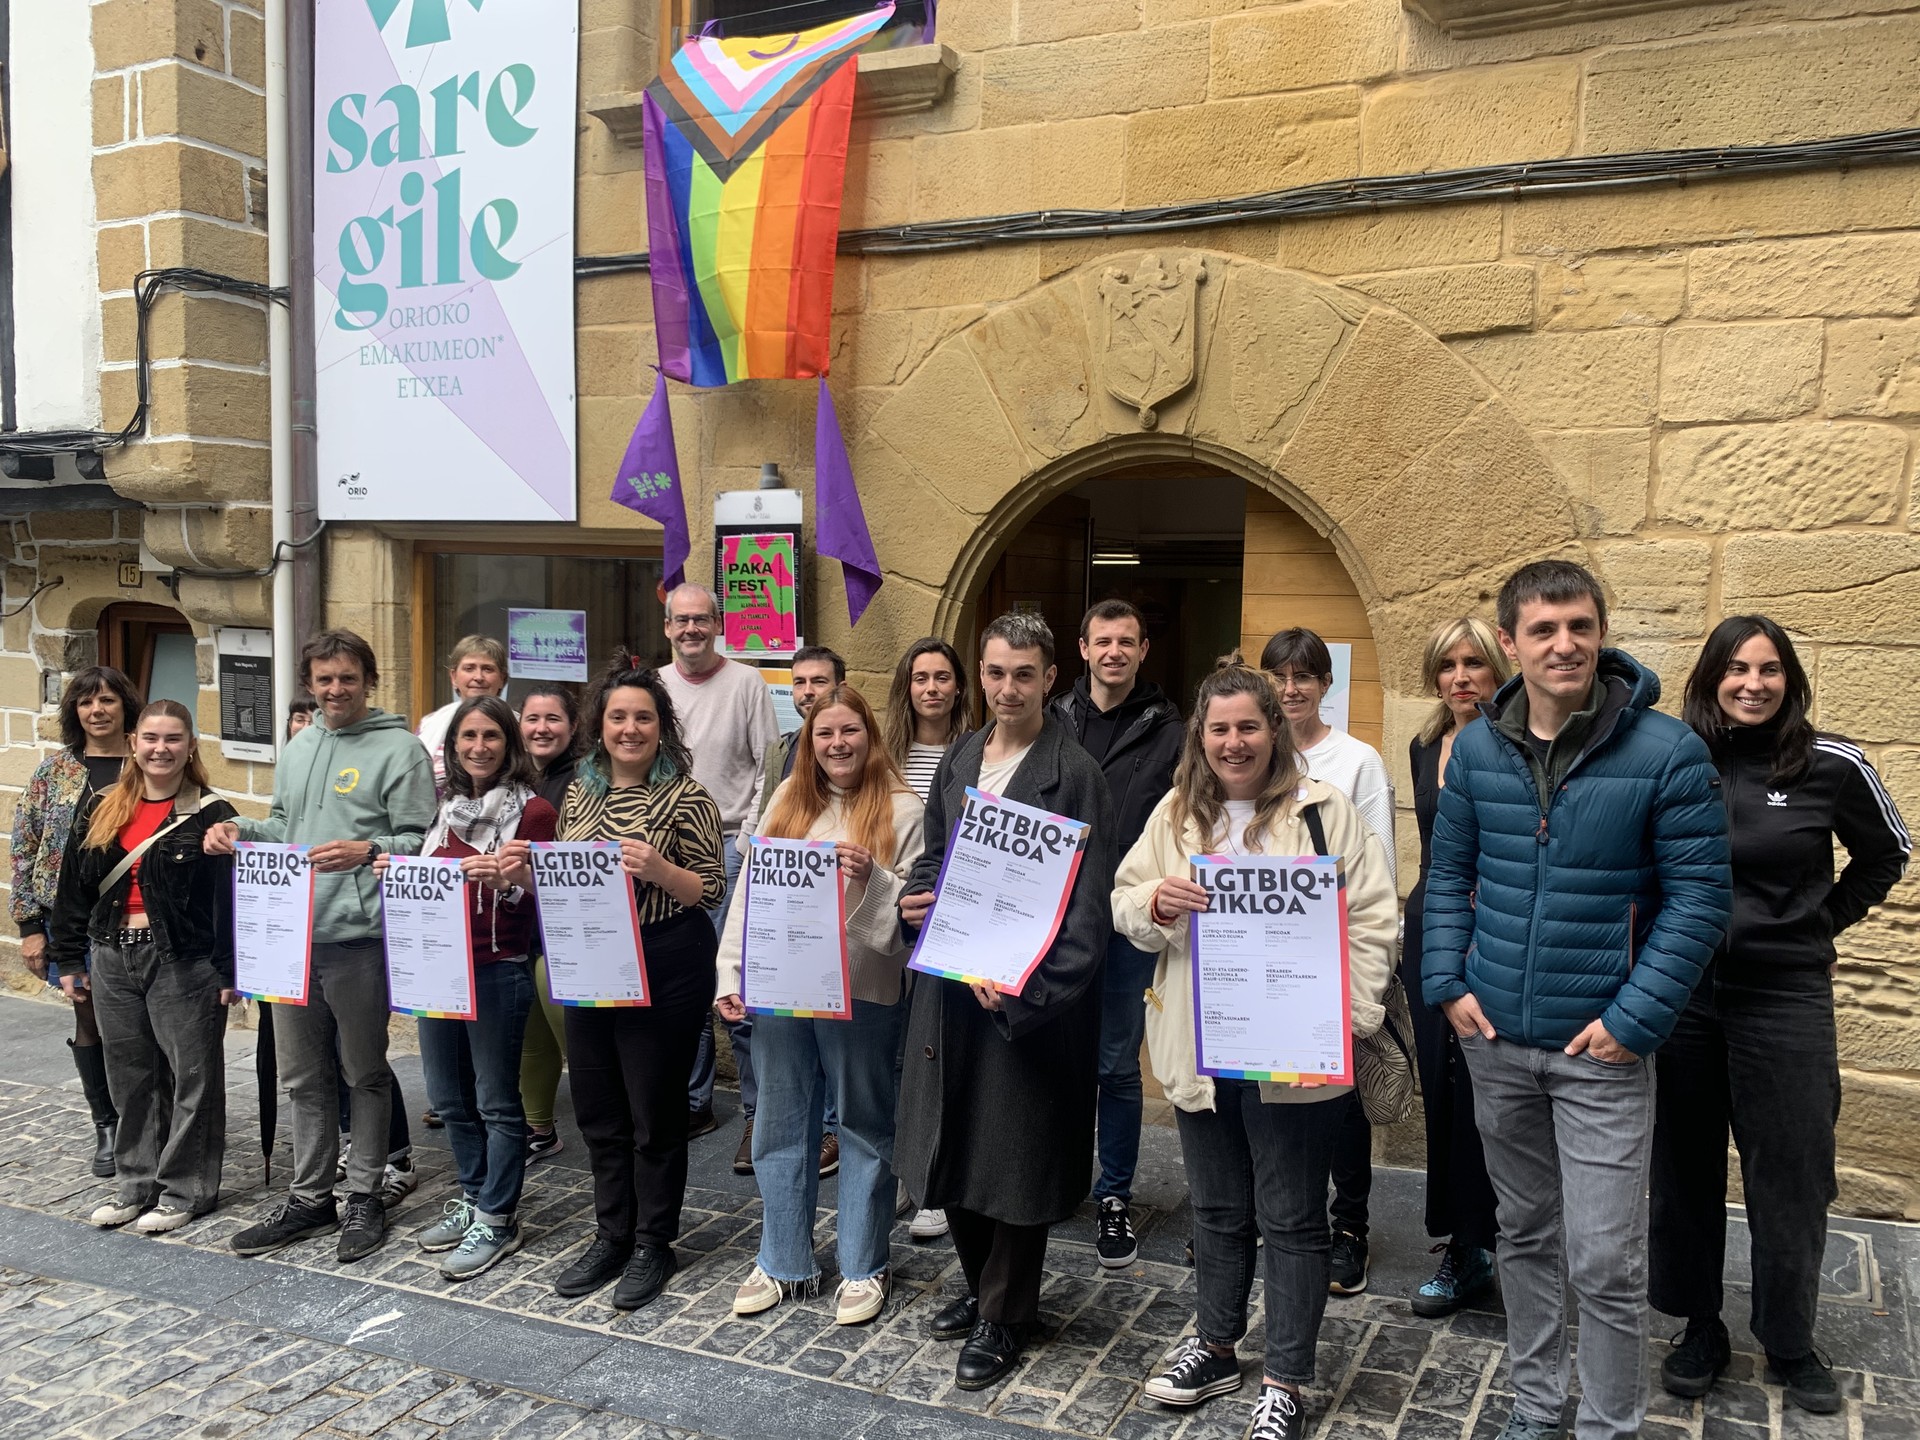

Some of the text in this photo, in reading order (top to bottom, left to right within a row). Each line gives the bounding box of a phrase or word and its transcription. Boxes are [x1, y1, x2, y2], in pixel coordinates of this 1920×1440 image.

[326, 63, 540, 174] sare
[335, 167, 523, 331] gile
[390, 302, 470, 329] ORIOKO
[397, 376, 463, 398] ETXEA
[348, 487, 368, 496] ORIO
[125, 566, 136, 582] 15
[728, 562, 772, 574] PAKA
[729, 580, 766, 592] FEST
[536, 645, 585, 656] TOPAKETA
[964, 800, 1076, 856] LGTBIQ+
[960, 821, 1044, 864] ZIKLOA
[238, 850, 309, 876] LGTBIQ+
[534, 851, 620, 875] LGTBIQ+
[752, 847, 835, 877] LGTBIQ+
[238, 868, 292, 886] ZIKLOA
[385, 865, 462, 891] LGTBIQ+
[537, 871, 605, 887] ZIKLOA
[751, 868, 814, 888] ZIKLOA
[1200, 868, 1334, 900] LGTBIQ+
[385, 884, 445, 901] ZIKLOA
[1200, 894, 1306, 914] ZIKLOA
